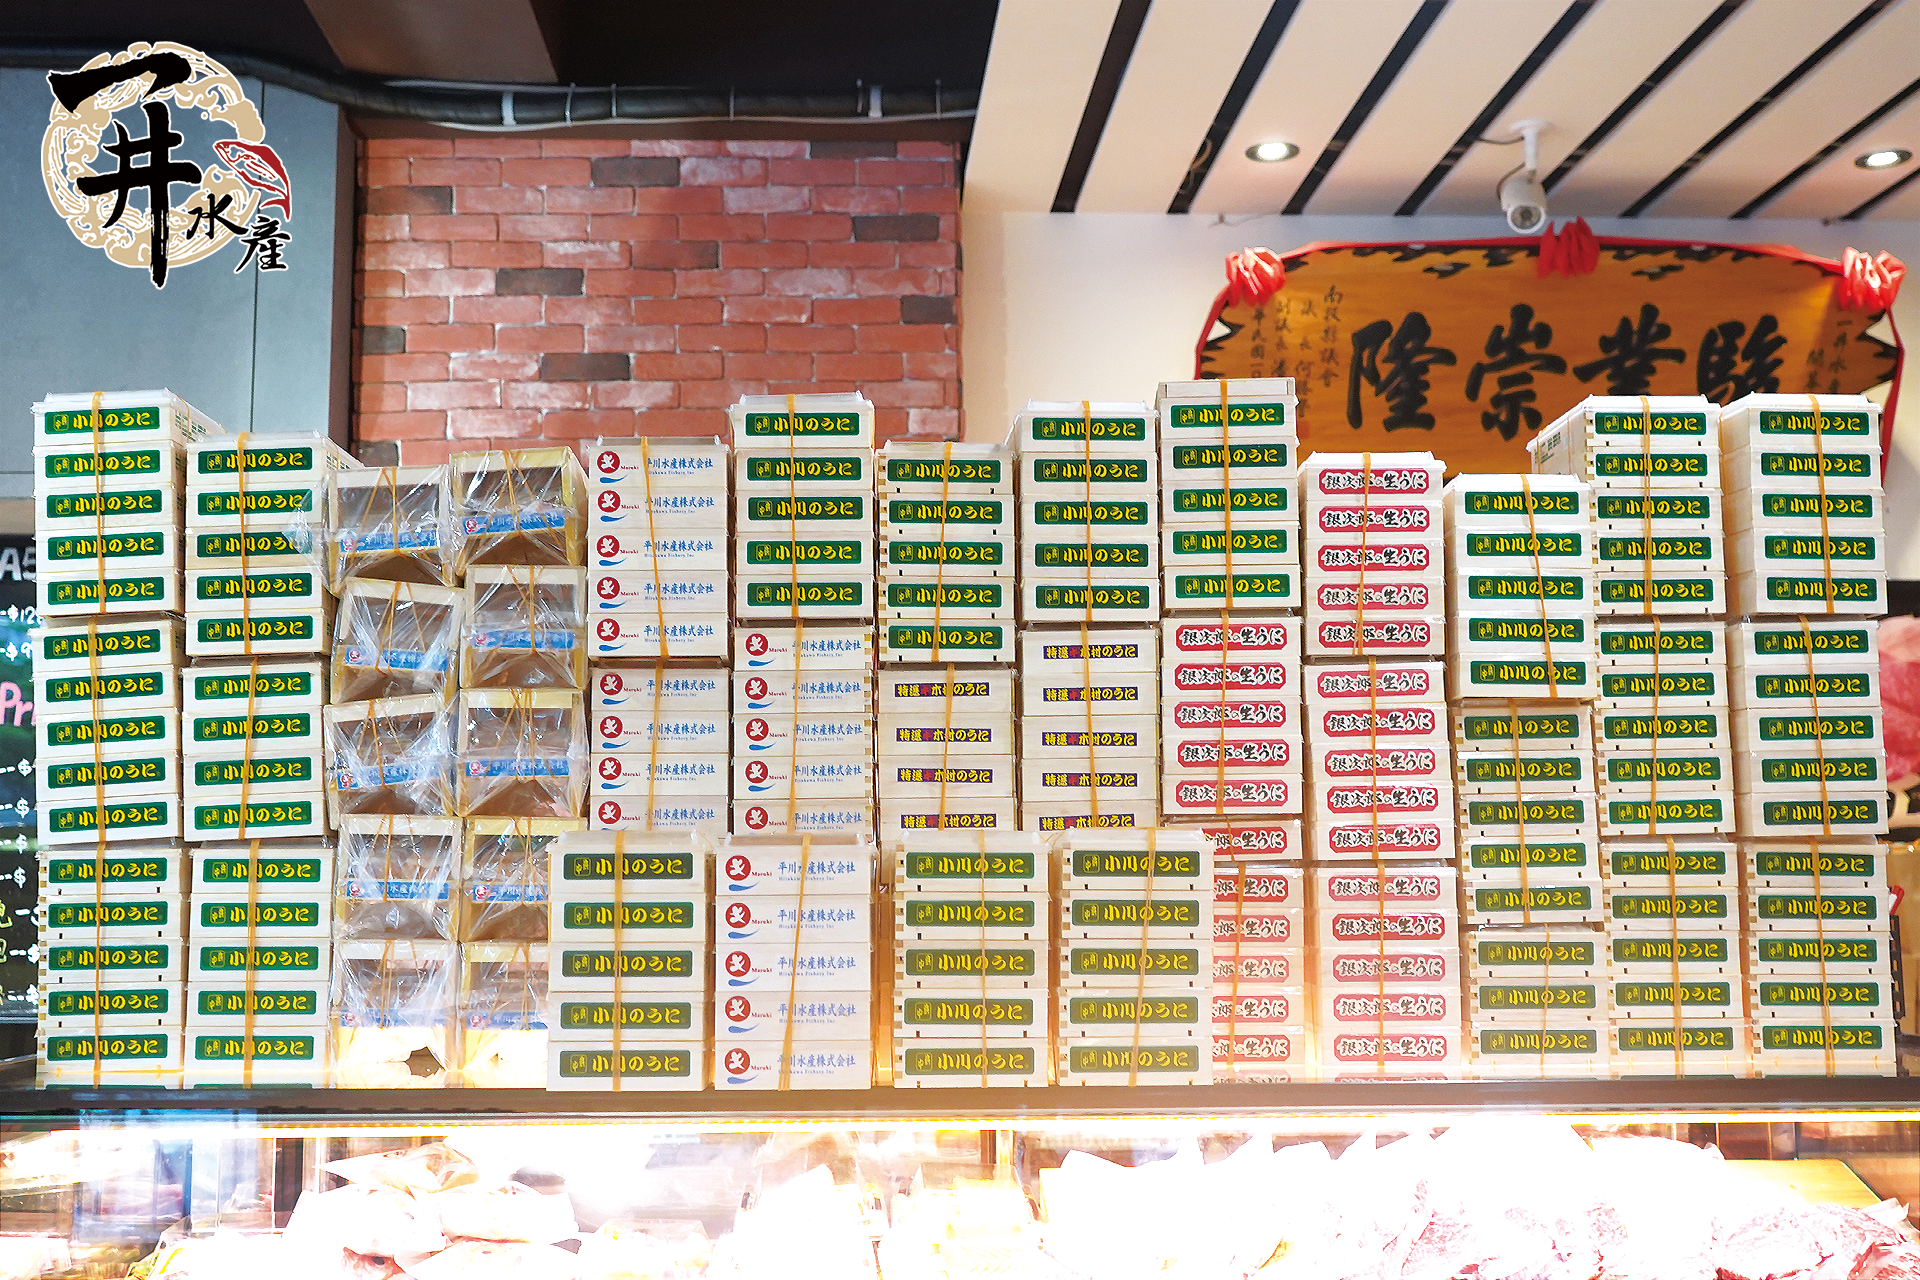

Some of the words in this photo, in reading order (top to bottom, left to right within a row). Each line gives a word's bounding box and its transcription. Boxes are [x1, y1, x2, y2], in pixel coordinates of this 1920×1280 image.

[774, 417, 849, 432] 小川のうに
[1061, 422, 1135, 436] 小川のうに
[1788, 415, 1860, 431] 小川のうに
[227, 453, 302, 469] 小川のうに
[776, 462, 851, 476] 小川のうに
[916, 463, 991, 479] 小川のうに
[1063, 463, 1138, 478] 小川のうに
[227, 493, 302, 511] 小川のうに
[777, 501, 853, 516] 小川のうに
[1494, 496, 1569, 510] 小川のうに
[1791, 498, 1863, 513] 小川のうに
[918, 504, 992, 520] 小川のうに
[1064, 506, 1138, 520] 小川のうに
[776, 545, 852, 560] 小川のうに
[918, 545, 993, 561] 小川のうに
[1496, 538, 1572, 552] 小川のうに
[1064, 548, 1139, 562] 小川のうに
[226, 578, 302, 595] 小川のうに
[1498, 580, 1573, 595] 小川のうに
[917, 588, 992, 603] 小川のうに
[1065, 590, 1140, 605] 小川のうに
[227, 620, 303, 638] 小川のうに
[1498, 622, 1574, 638] 小川のうに
[1629, 636, 1704, 650] 小川のうに
[1784, 634, 1858, 650] 小川のうに
[1631, 677, 1705, 692] 小川のうに
[1785, 678, 1860, 694] 小川のうに
[1633, 719, 1707, 735] 小川のうに
[1789, 720, 1864, 736] 小川のうに
[1637, 761, 1711, 778] 小川のうに
[1791, 761, 1867, 778] 小川のうに
[1638, 803, 1713, 820] 小川のうに
[939, 856, 1023, 874] 小川のうに
[1105, 855, 1189, 873] 小川のうに
[1641, 855, 1716, 871] 小川のうに
[1786, 856, 1864, 872] 小川のうに
[938, 905, 1023, 922] 小川のうに
[1104, 904, 1188, 922] 小川のうに
[1641, 899, 1717, 915] 小川のうに
[1788, 899, 1866, 915] 小川のうに
[1507, 946, 1584, 960] 小川のうに
[1789, 943, 1867, 958] 小川のうに
[938, 953, 1023, 971] 小川のうに
[1103, 953, 1187, 970] 小川のうに
[1509, 989, 1585, 1004] 小川のうに
[1790, 986, 1869, 1002] 小川のうに
[937, 1003, 1022, 1020] 小川のうに
[1102, 1002, 1186, 1019] 小川のうに
[1509, 1034, 1586, 1049] 小川のうに
[1648, 1031, 1724, 1047] 小川のうに
[1793, 1030, 1872, 1045] 小川のうに
[938, 1052, 1023, 1070] 小川のうに
